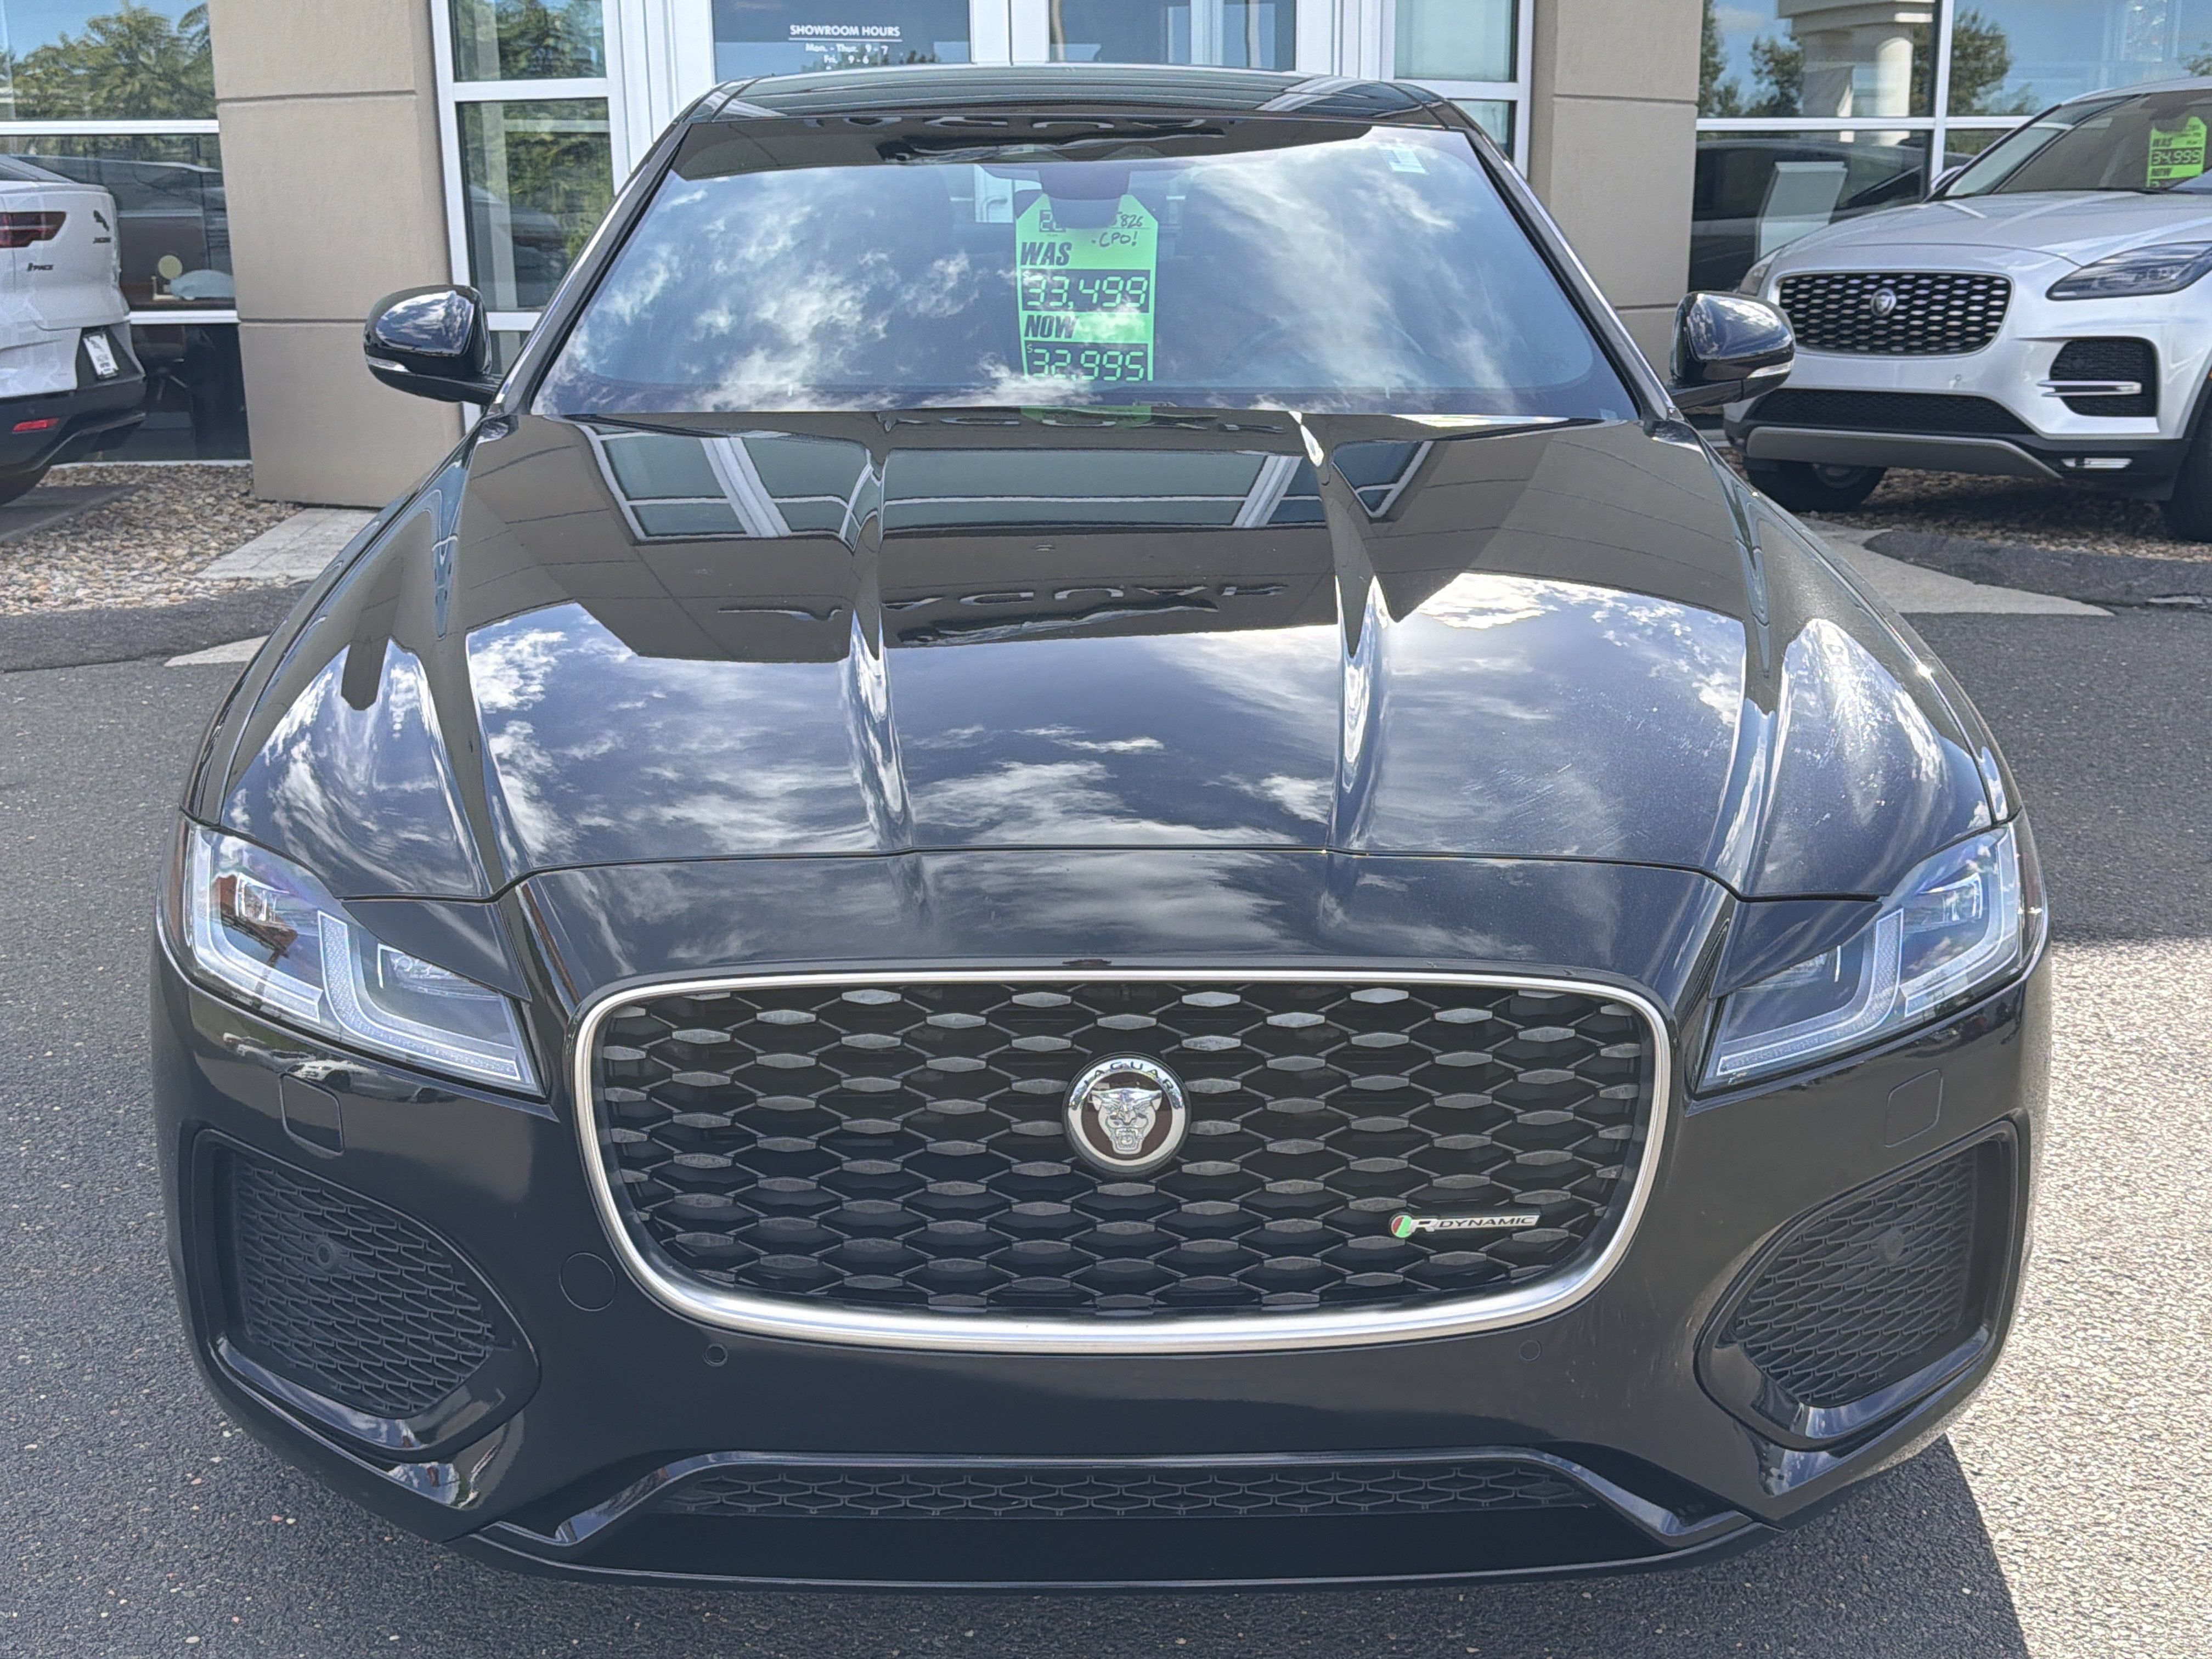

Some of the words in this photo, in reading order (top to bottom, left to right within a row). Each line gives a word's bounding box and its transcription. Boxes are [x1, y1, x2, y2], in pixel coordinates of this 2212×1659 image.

[790, 25, 859, 36] SHOWROOM
[862, 26, 900, 37] HOURS
[881, 45, 888, 55] 7
[862, 55, 869, 64] 6
[1020, 241, 1072, 266] WAS
[1024, 314, 1079, 338] NOW
[1439, 1217, 1536, 1228] DYNAMIC
